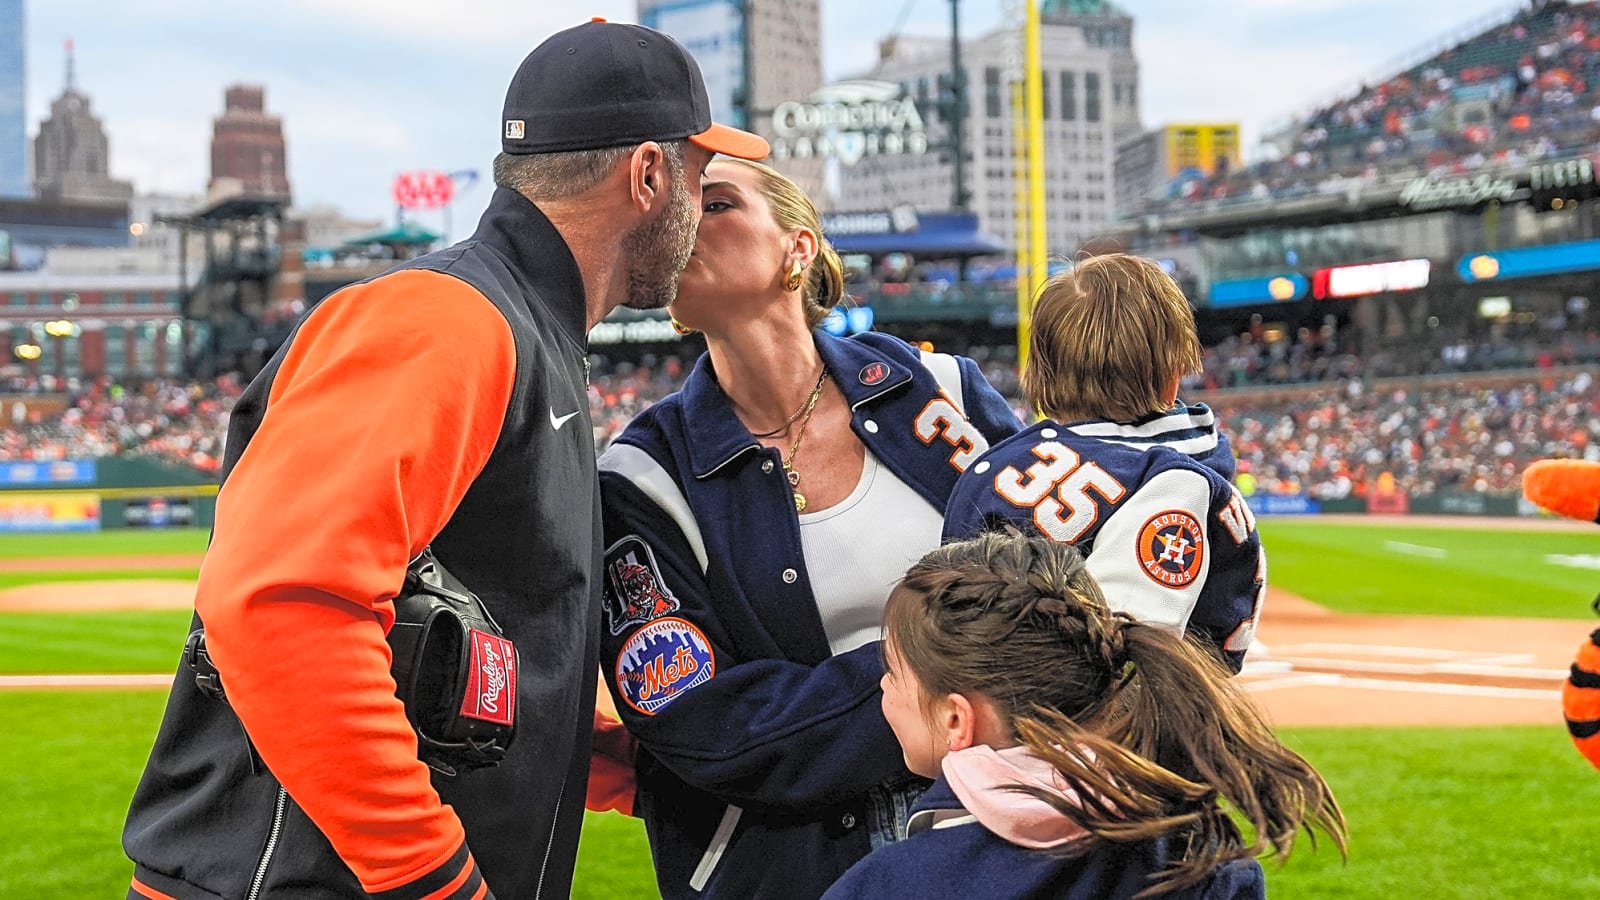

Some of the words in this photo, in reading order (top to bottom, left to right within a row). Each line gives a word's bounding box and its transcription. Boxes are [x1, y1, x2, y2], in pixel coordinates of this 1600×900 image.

[994, 440, 1127, 544] 35
[1152, 513, 1202, 543] HOUSTON
[1145, 560, 1191, 583] ASTROS
[481, 640, 500, 713] Rawlings
[638, 645, 699, 701] Mets
